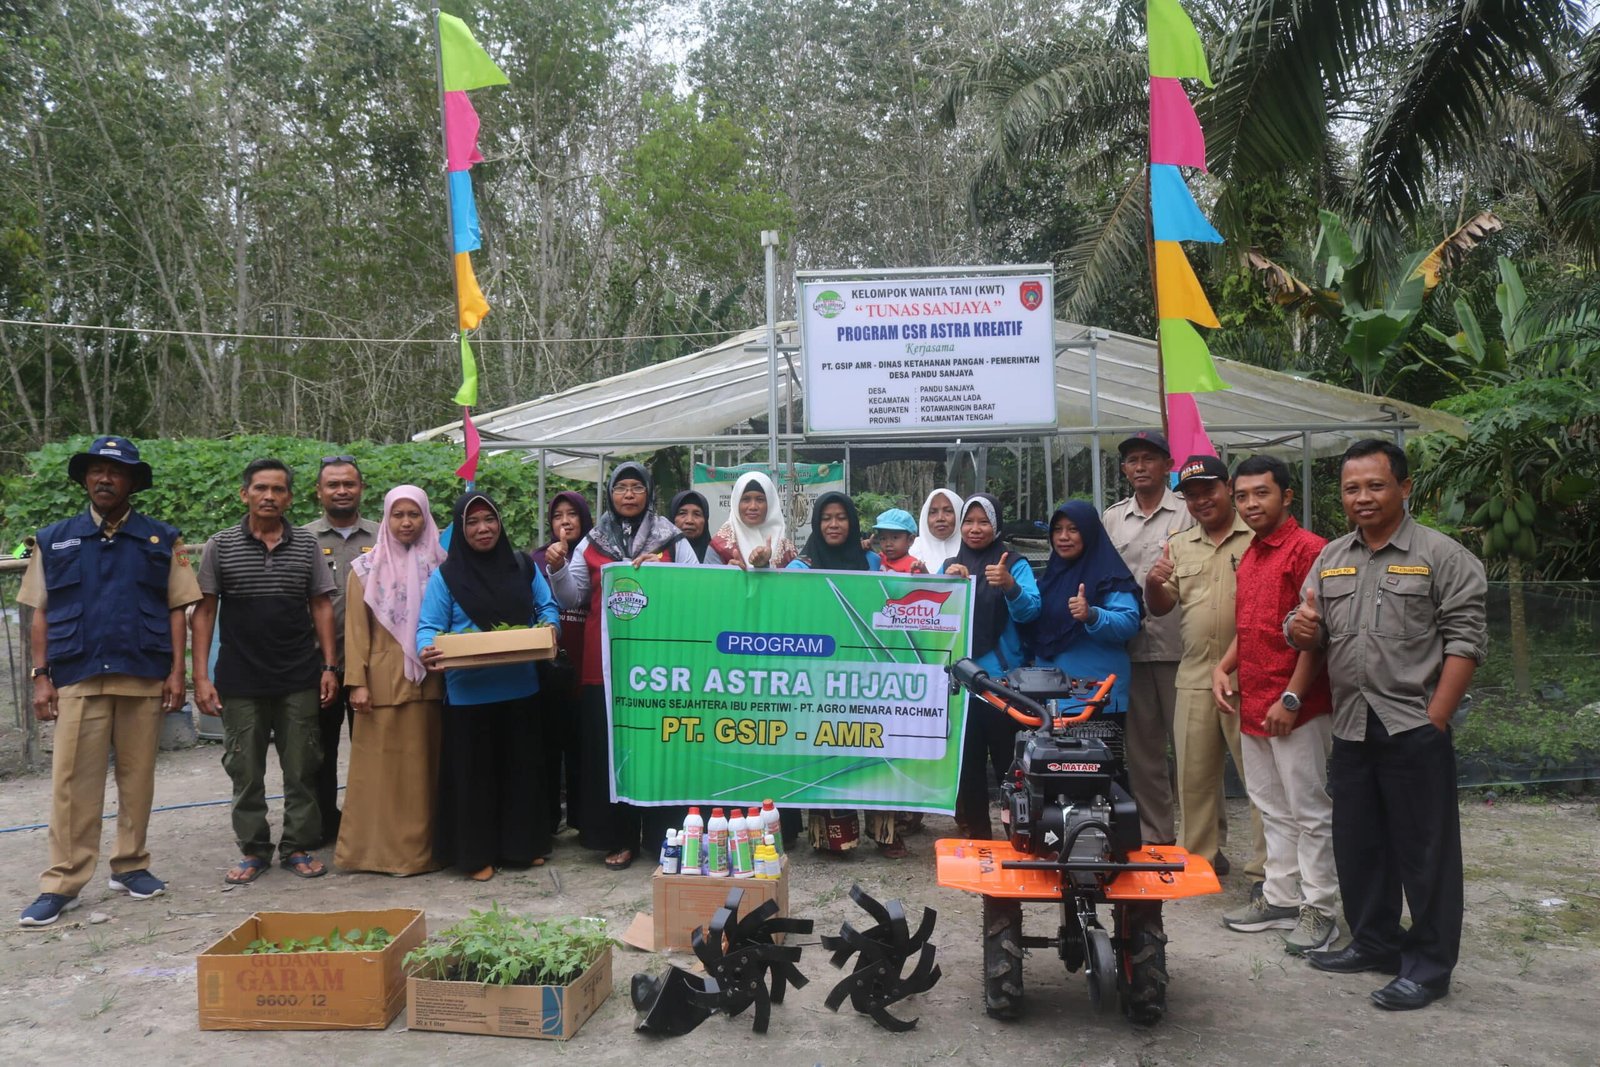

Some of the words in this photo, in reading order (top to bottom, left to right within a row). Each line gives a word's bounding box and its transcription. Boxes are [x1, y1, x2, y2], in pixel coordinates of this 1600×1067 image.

[852, 288, 907, 299] KELOMPOK
[910, 286, 948, 297] WANITA
[950, 285, 972, 296] TANI
[975, 284, 1005, 296] (KWT)
[837, 325, 899, 342] PROGRAM
[902, 324, 927, 340] CSR
[930, 322, 971, 338] ASTRA
[973, 321, 1023, 337] KREATIF
[905, 342, 955, 356] Kerjasama
[835, 362, 853, 370] GSIP
[855, 361, 872, 369] AMR
[878, 360, 902, 369] DINAS
[904, 359, 951, 368] KETAHANAN
[953, 358, 984, 366] PANGAN
[991, 356, 1040, 365] PEMERINTAH
[889, 371, 909, 379] DESA
[911, 370, 937, 378] PANDU
[939, 369, 974, 377] SANJAYA
[868, 387, 887, 395] DESA
[920, 385, 943, 393] PANDU
[944, 384, 975, 392] SANJAYA
[868, 396, 910, 404] KECAMATAN
[868, 406, 909, 414] KABUPATEN
[920, 404, 972, 412] KOTAWARINGIN
[973, 403, 996, 411] BARAT
[869, 416, 901, 424] PROVINSI
[921, 414, 964, 422] KALIMANTAN
[966, 413, 993, 421] TENGAH
[897, 605, 934, 618] satu
[891, 614, 940, 626] Indonesia
[727, 635, 823, 654] PROGRAM
[628, 665, 691, 693] CSR
[703, 667, 813, 697] ASTRA
[825, 671, 928, 701] HIJAU
[668, 698, 728, 711] SEJAHTERA
[730, 701, 747, 711] IBU
[750, 702, 792, 713] PERTIWI
[800, 703, 815, 713] PT.
[816, 703, 847, 714] AGRO
[849, 704, 892, 715] MENARA
[894, 706, 944, 717] RACHMAT
[661, 716, 704, 743] PT.
[714, 717, 788, 746] GSIP
[813, 720, 884, 748] AMR
[1062, 763, 1098, 771] MATARI
[251, 953, 329, 968] GUDANG
[235, 968, 345, 992] GARAM
